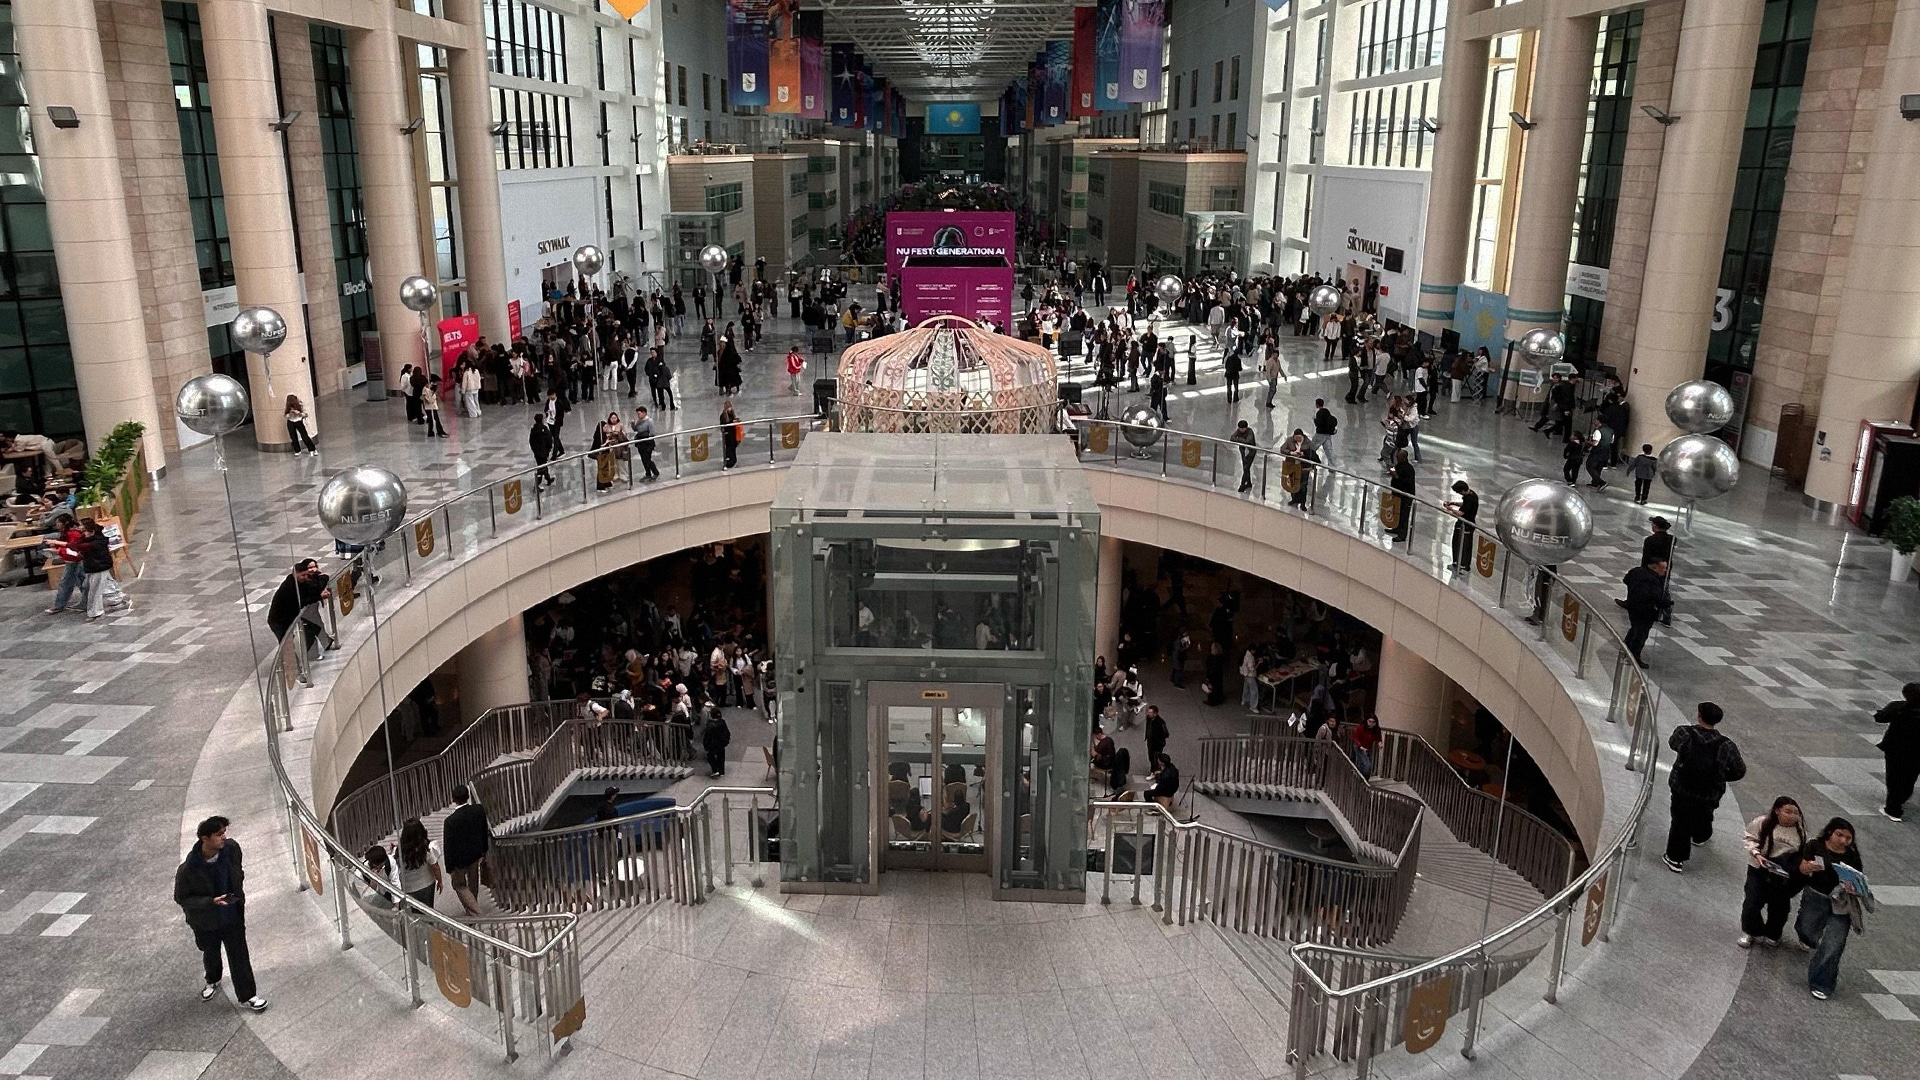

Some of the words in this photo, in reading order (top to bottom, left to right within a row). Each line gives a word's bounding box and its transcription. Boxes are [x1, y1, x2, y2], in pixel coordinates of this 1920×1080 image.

[538, 236, 570, 255] SKYWALK
[896, 247, 910, 255] NU
[911, 247, 935, 255] FEST:
[936, 247, 994, 255] GENERATION
[995, 247, 1005, 255] AI
[1347, 235, 1384, 258] SKYWALK
[343, 280, 367, 296] Block
[1711, 287, 1735, 331] 3
[341, 515, 358, 524] NU
[362, 508, 392, 522] FEST
[1511, 525, 1530, 538] NU
[1532, 532, 1569, 545] FEST
